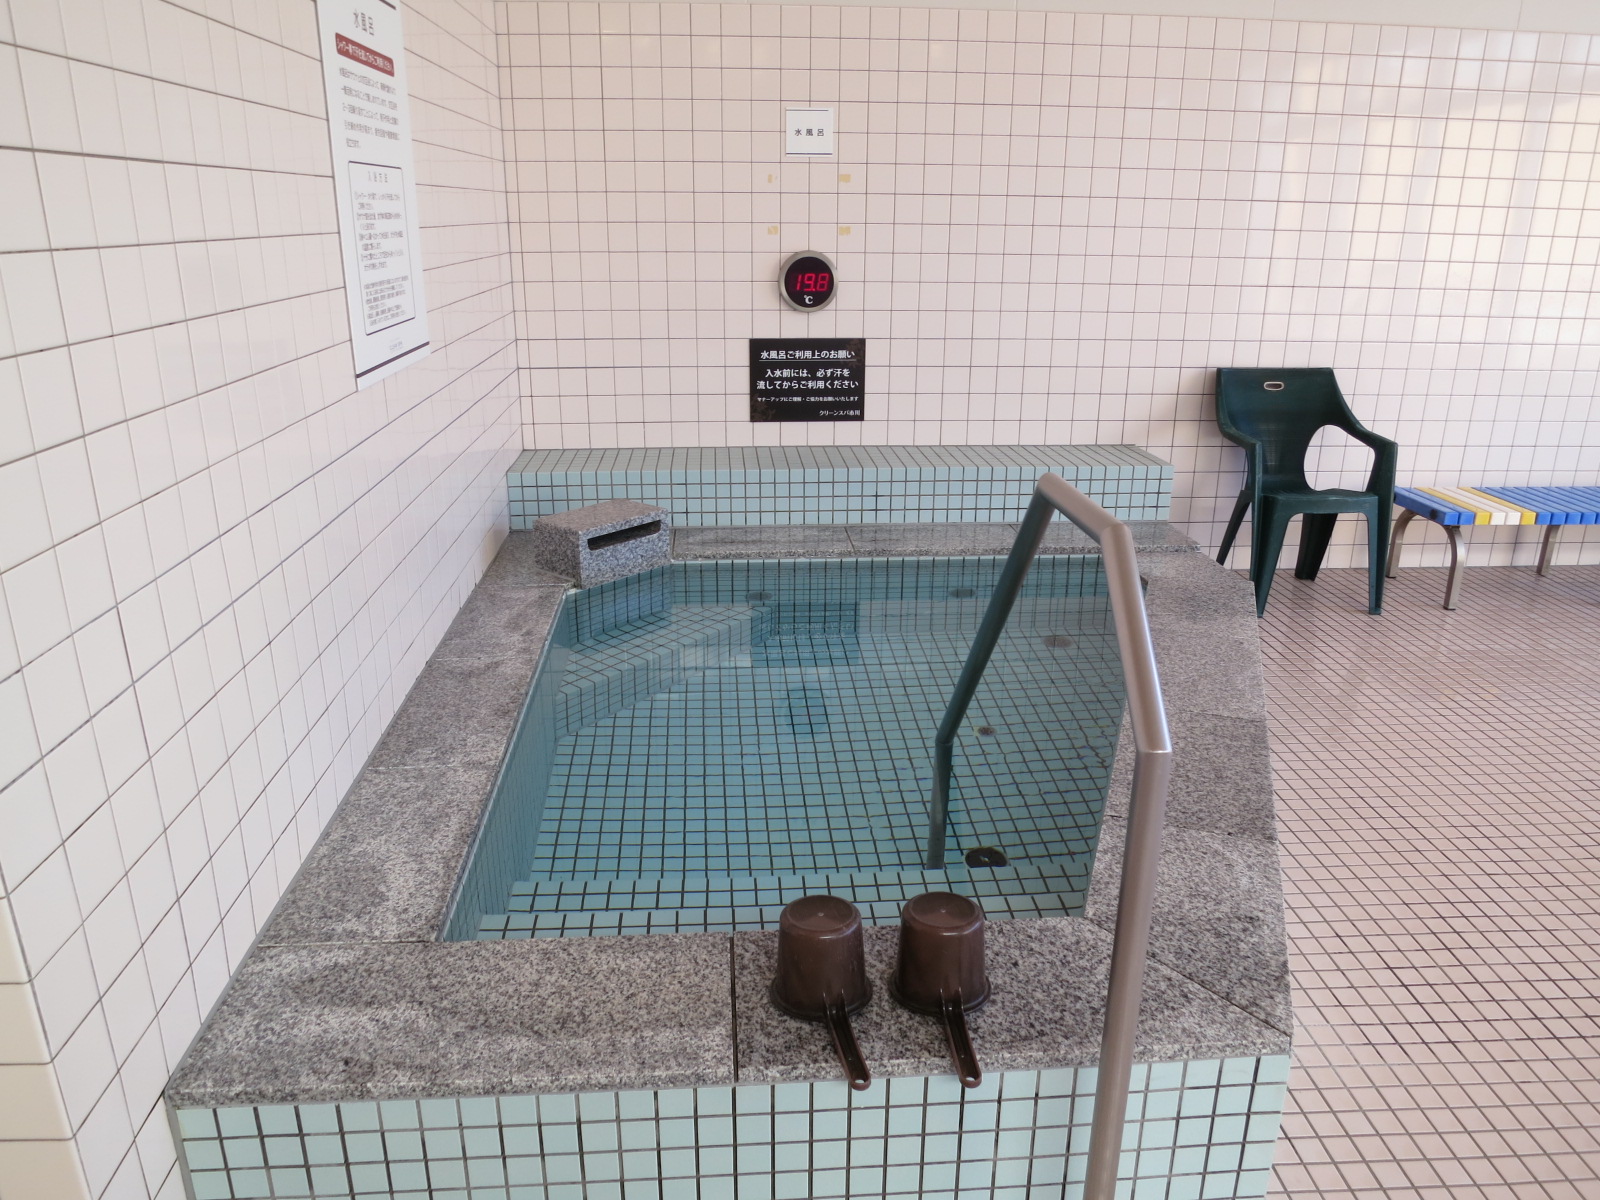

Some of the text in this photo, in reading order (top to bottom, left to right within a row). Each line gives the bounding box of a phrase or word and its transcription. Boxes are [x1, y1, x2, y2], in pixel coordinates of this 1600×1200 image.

[353, 9, 375, 36] 水風呂
[794, 128, 825, 137] 水風呂
[795, 273, 829, 292] 19.8
[760, 350, 856, 359] 水風呂ご利用上のお願い
[765, 368, 851, 378] 入水前には、必ず汗を
[756, 380, 859, 390] 流してからご利用ください
